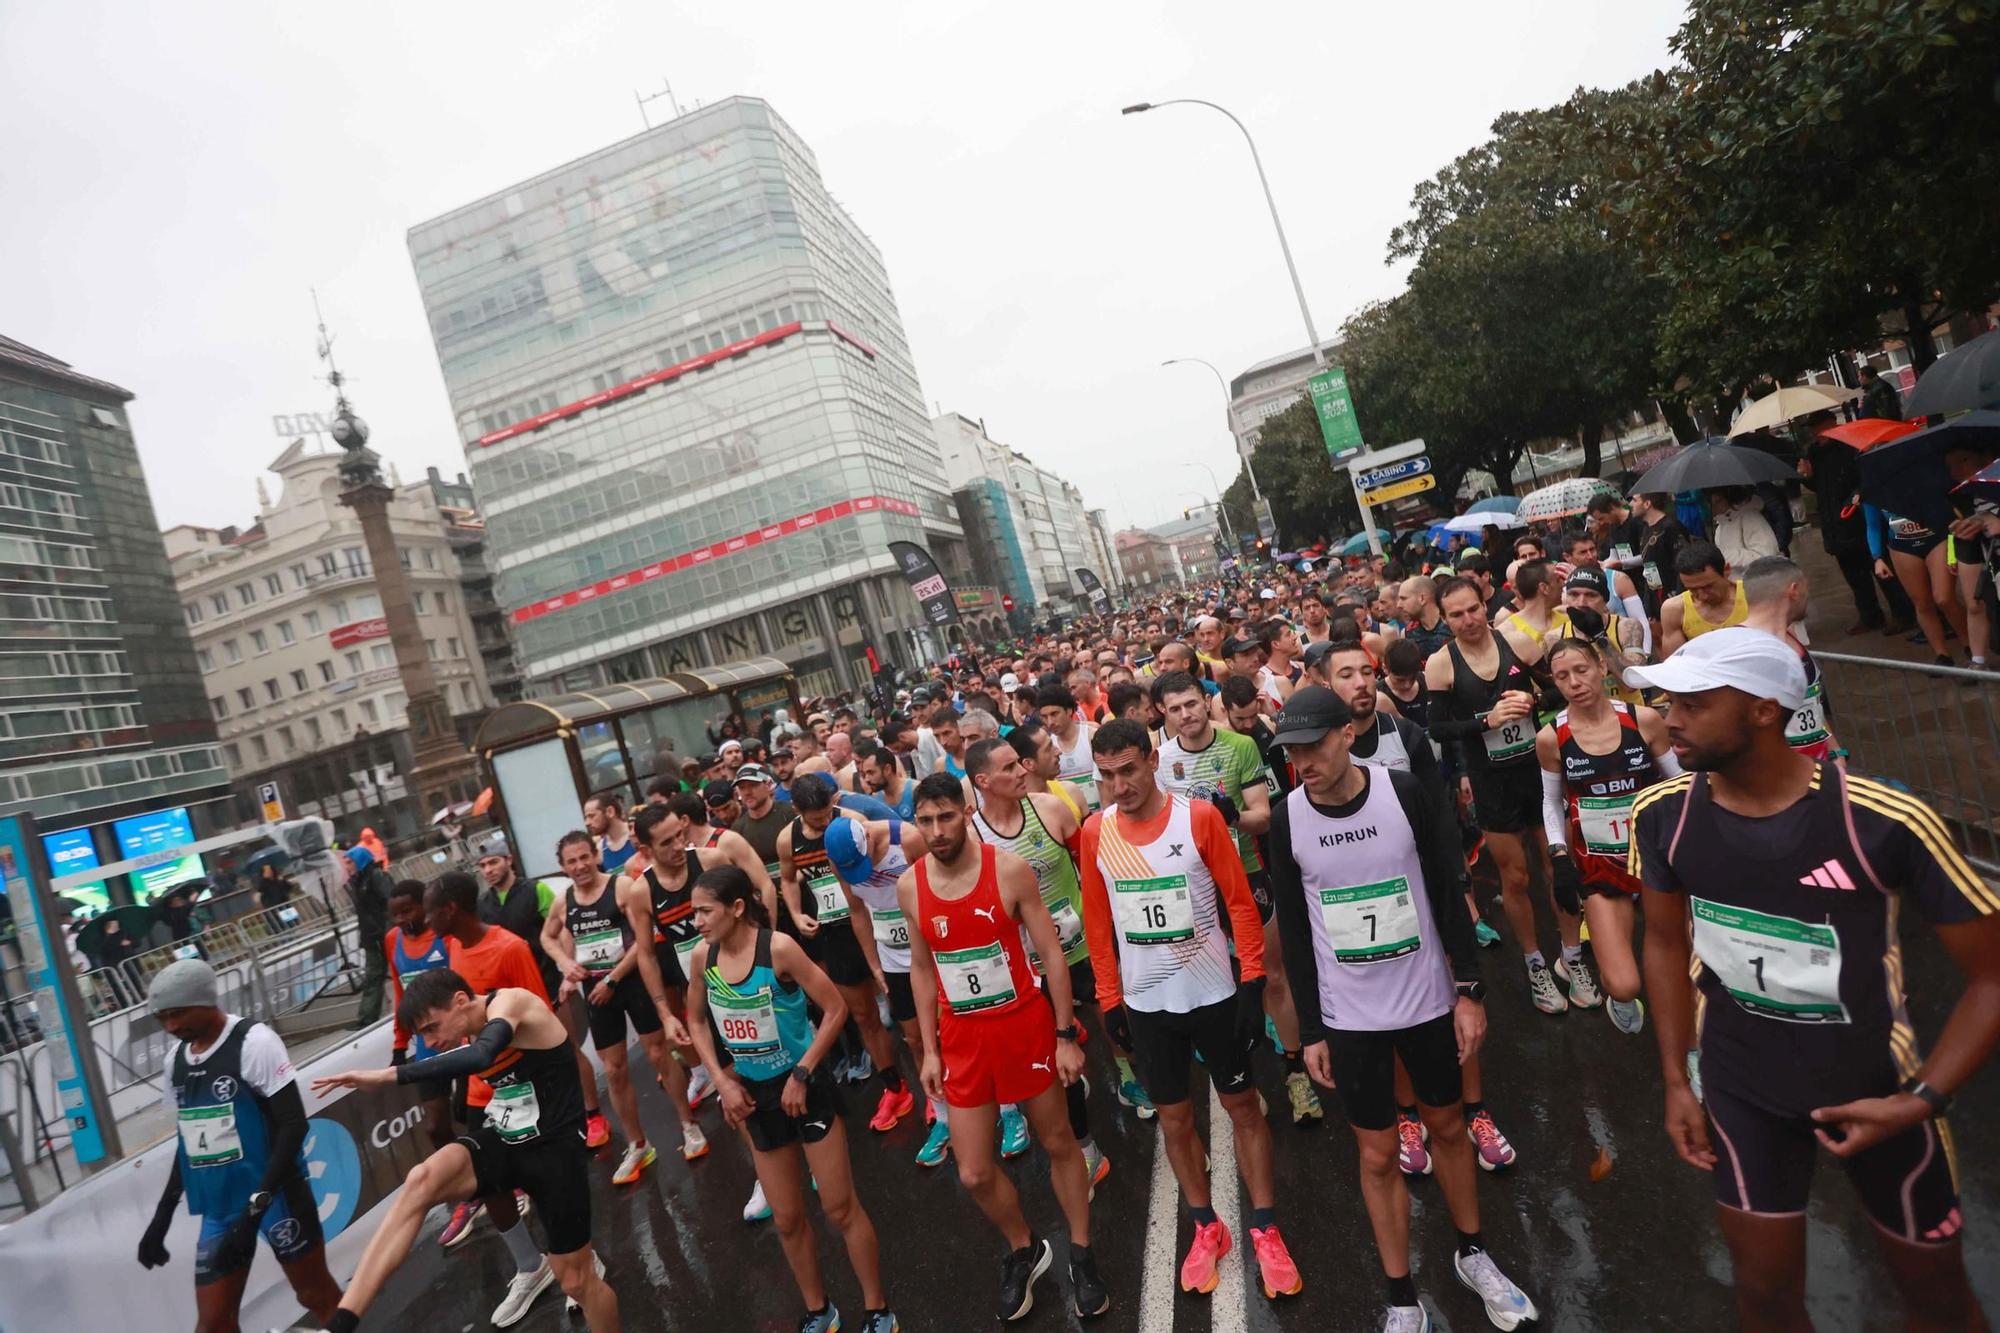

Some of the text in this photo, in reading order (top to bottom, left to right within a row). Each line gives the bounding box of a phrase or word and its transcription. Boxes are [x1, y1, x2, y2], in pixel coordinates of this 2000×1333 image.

[1797, 709, 1816, 731] 33
[1502, 724, 1524, 745] 82
[261, 786, 273, 798] P
[1608, 777, 1636, 793] BM
[1319, 825, 1378, 848] KIPRUN
[823, 893, 835, 909] 27
[1142, 904, 1167, 928] 16
[890, 926, 909, 943] 28
[1363, 914, 1376, 942] 7
[967, 973, 982, 995] 8
[1748, 956, 1766, 993] 1
[723, 1018, 758, 1040] 986
[501, 1107, 512, 1129] 6
[198, 1131, 208, 1151] 4
